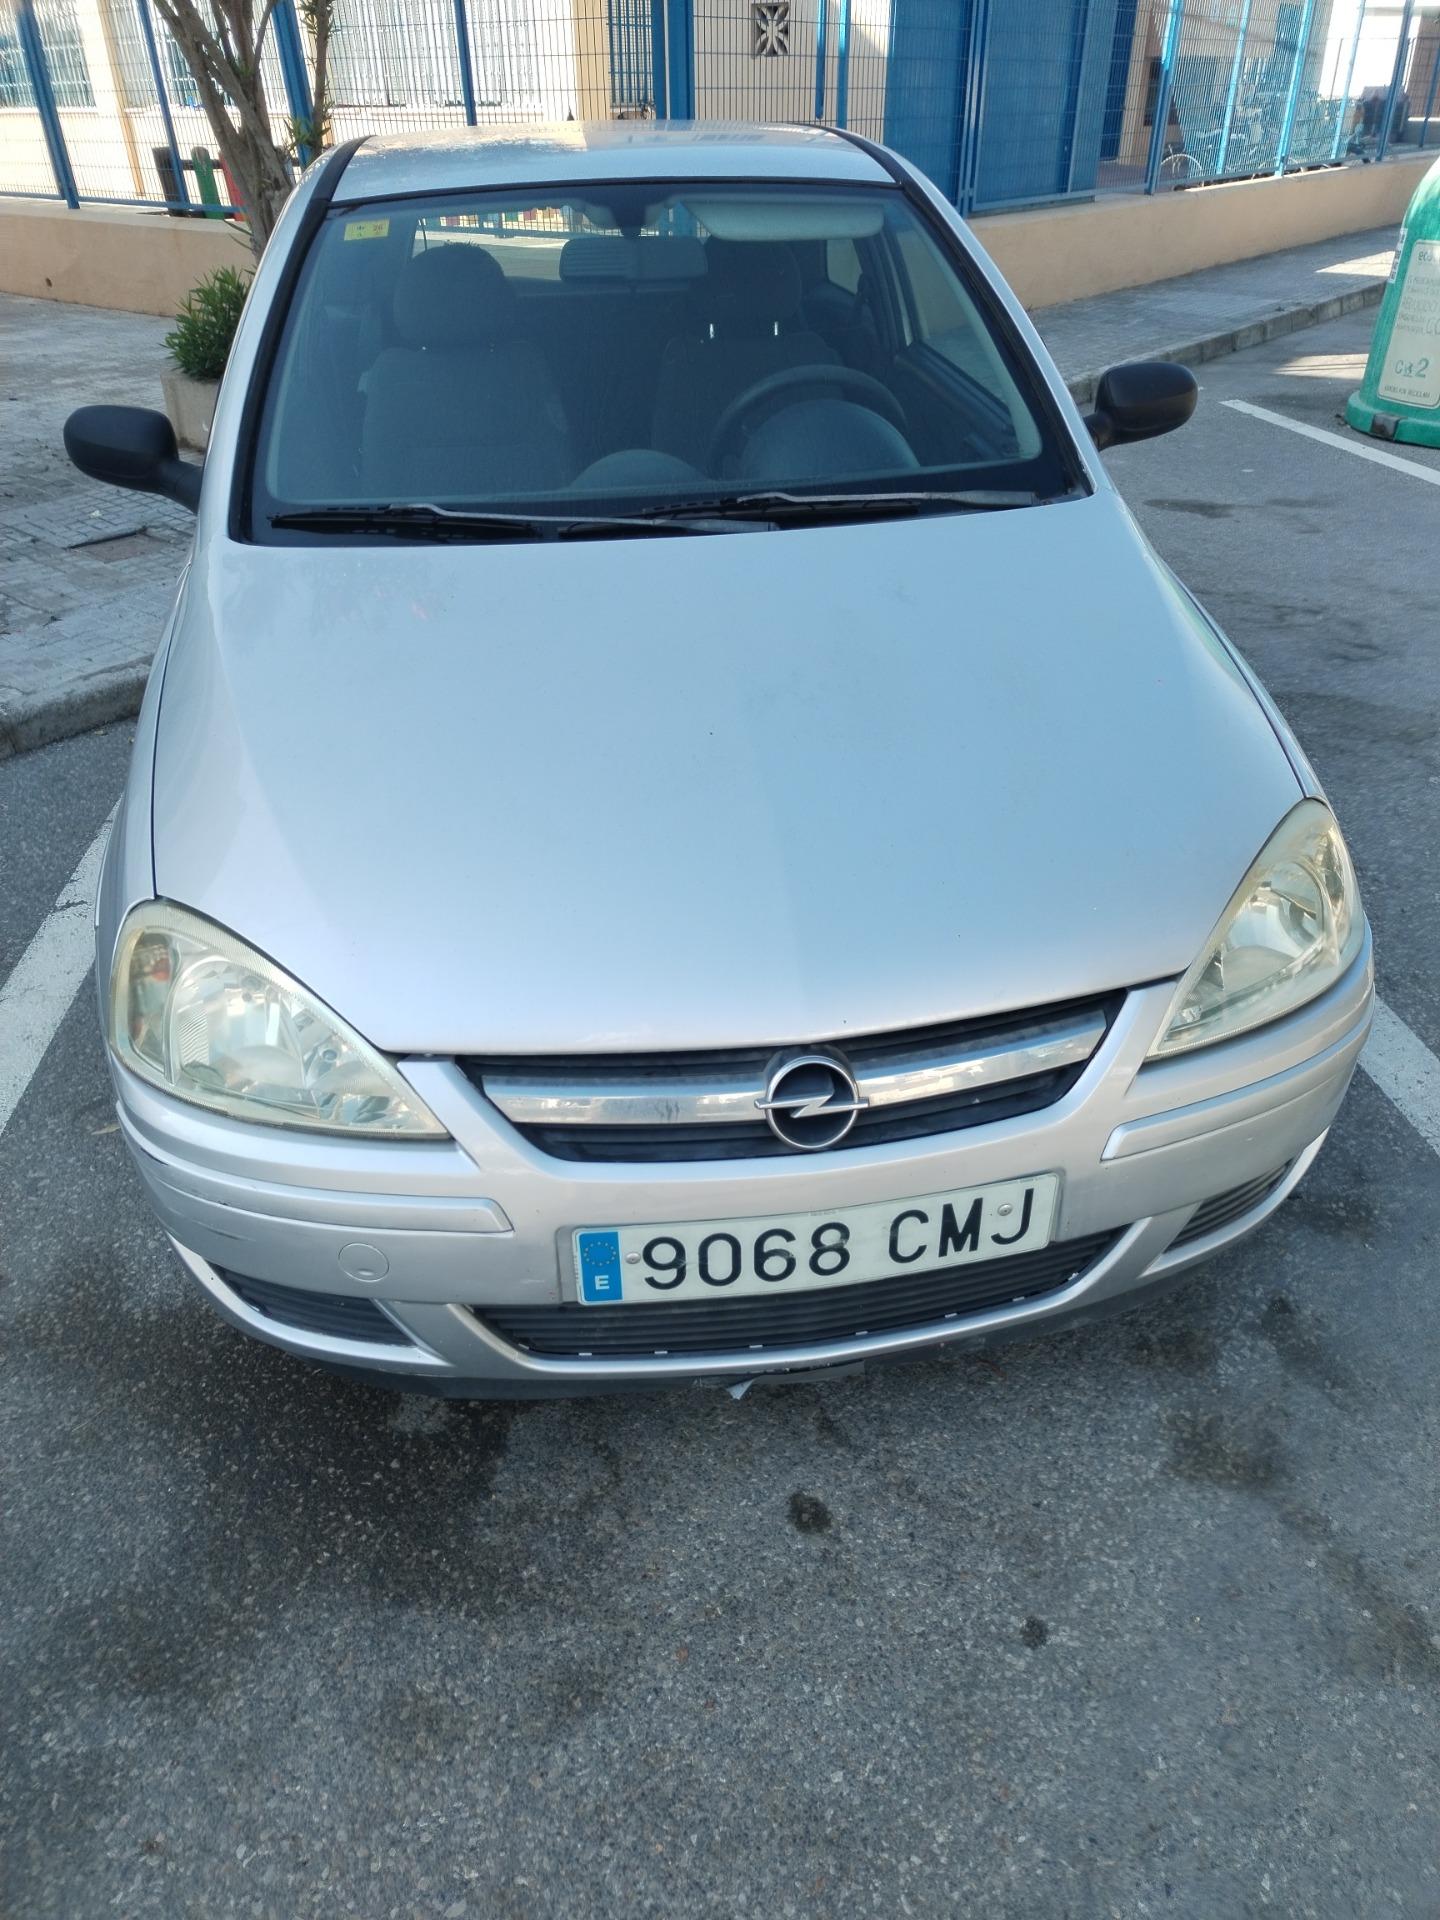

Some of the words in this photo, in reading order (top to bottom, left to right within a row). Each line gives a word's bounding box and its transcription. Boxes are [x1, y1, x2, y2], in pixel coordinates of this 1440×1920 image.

[642, 1222, 850, 1290] 9068
[888, 1187, 1035, 1264] CMJ
[595, 1275, 610, 1290] E
